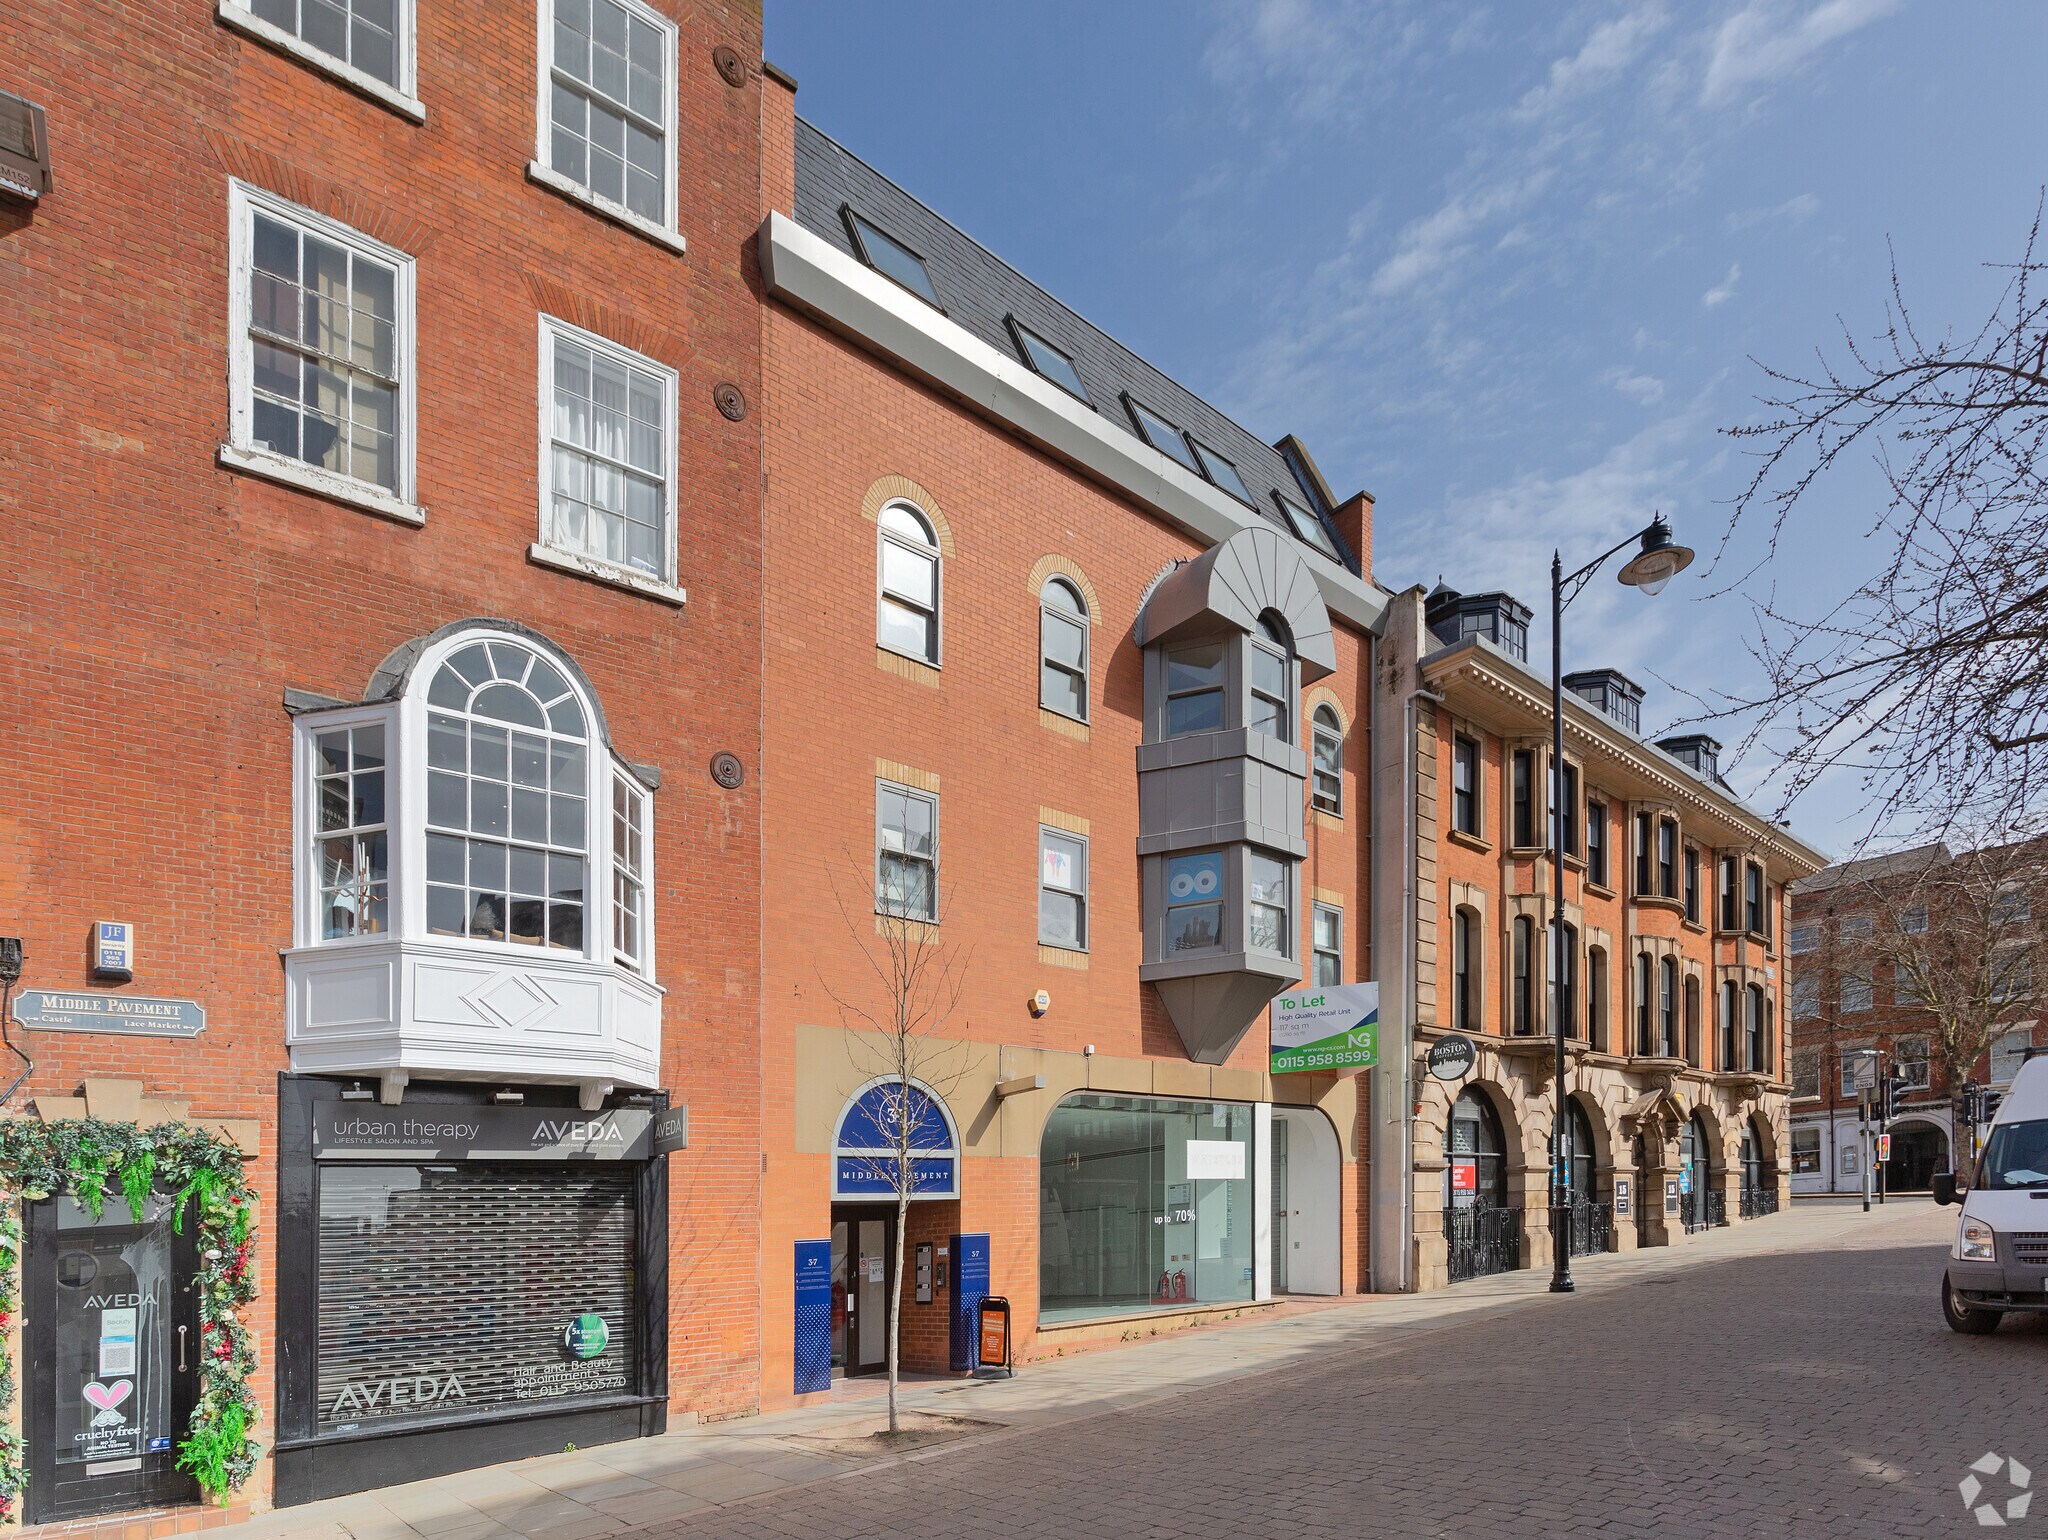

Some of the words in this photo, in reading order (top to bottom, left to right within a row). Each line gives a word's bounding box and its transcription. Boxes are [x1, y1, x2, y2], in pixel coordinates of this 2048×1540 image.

[0, 166, 31, 184] M152
[105, 926, 121, 938] JF
[41, 995, 101, 1011] MIDDLE
[107, 999, 181, 1016] PAVEMENT
[1279, 998, 1296, 1010] To
[1302, 995, 1325, 1008] Let
[41, 1014, 72, 1023] Castle
[1295, 1011, 1317, 1020] Quality
[1319, 1009, 1336, 1017] Retail
[124, 1019, 145, 1027] Lace
[148, 1021, 181, 1030] Market
[1348, 1032, 1371, 1049] NG
[1303, 1045, 1346, 1053] www.ng-cs.com
[1434, 1043, 1467, 1056] BOSTON
[1277, 1056, 1305, 1068] 0115
[1307, 1053, 1333, 1066] 958
[1335, 1050, 1371, 1064] 8599
[334, 1117, 396, 1135] urban
[403, 1118, 480, 1140] therapy
[532, 1120, 624, 1141] AVEDA
[654, 1118, 682, 1139] AVEDA
[1618, 1184, 1627, 1195] 15
[1667, 1184, 1676, 1195] 15
[1154, 1216, 1163, 1225] up
[1164, 1215, 1171, 1223] to
[1175, 1209, 1196, 1222] 70%
[83, 1293, 158, 1309] AVEDA
[571, 1327, 580, 1335] 5x
[513, 1366, 538, 1378] Hair
[543, 1362, 566, 1374] and
[571, 1358, 614, 1371] Beauty
[513, 1369, 600, 1389] appointments
[331, 1373, 467, 1412] AVEDA
[514, 1388, 534, 1399] Tel:
[540, 1384, 568, 1396] 0115
[575, 1376, 627, 1392] 9505770
